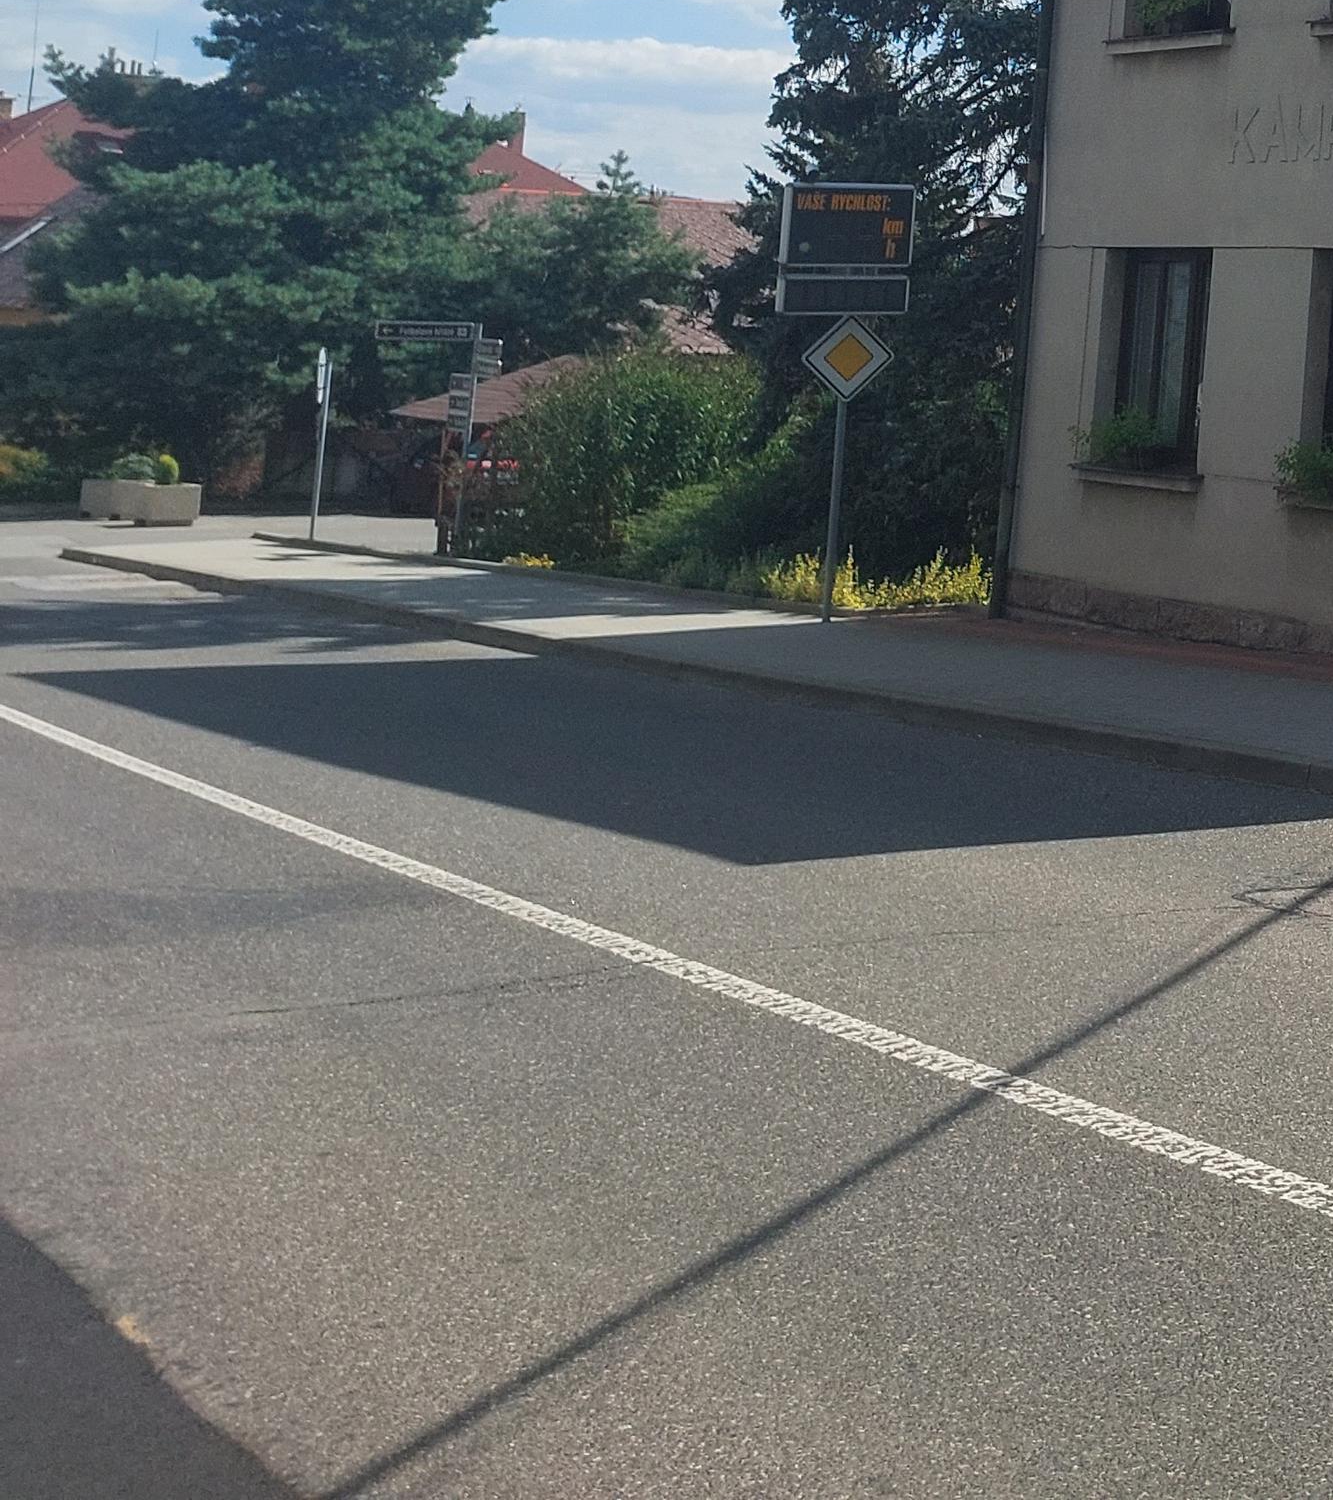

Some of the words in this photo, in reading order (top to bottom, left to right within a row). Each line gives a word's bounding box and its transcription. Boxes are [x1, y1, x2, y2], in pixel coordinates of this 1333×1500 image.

[797, 190, 826, 210] VAŠE
[883, 217, 905, 234] km
[885, 239, 897, 259] h
